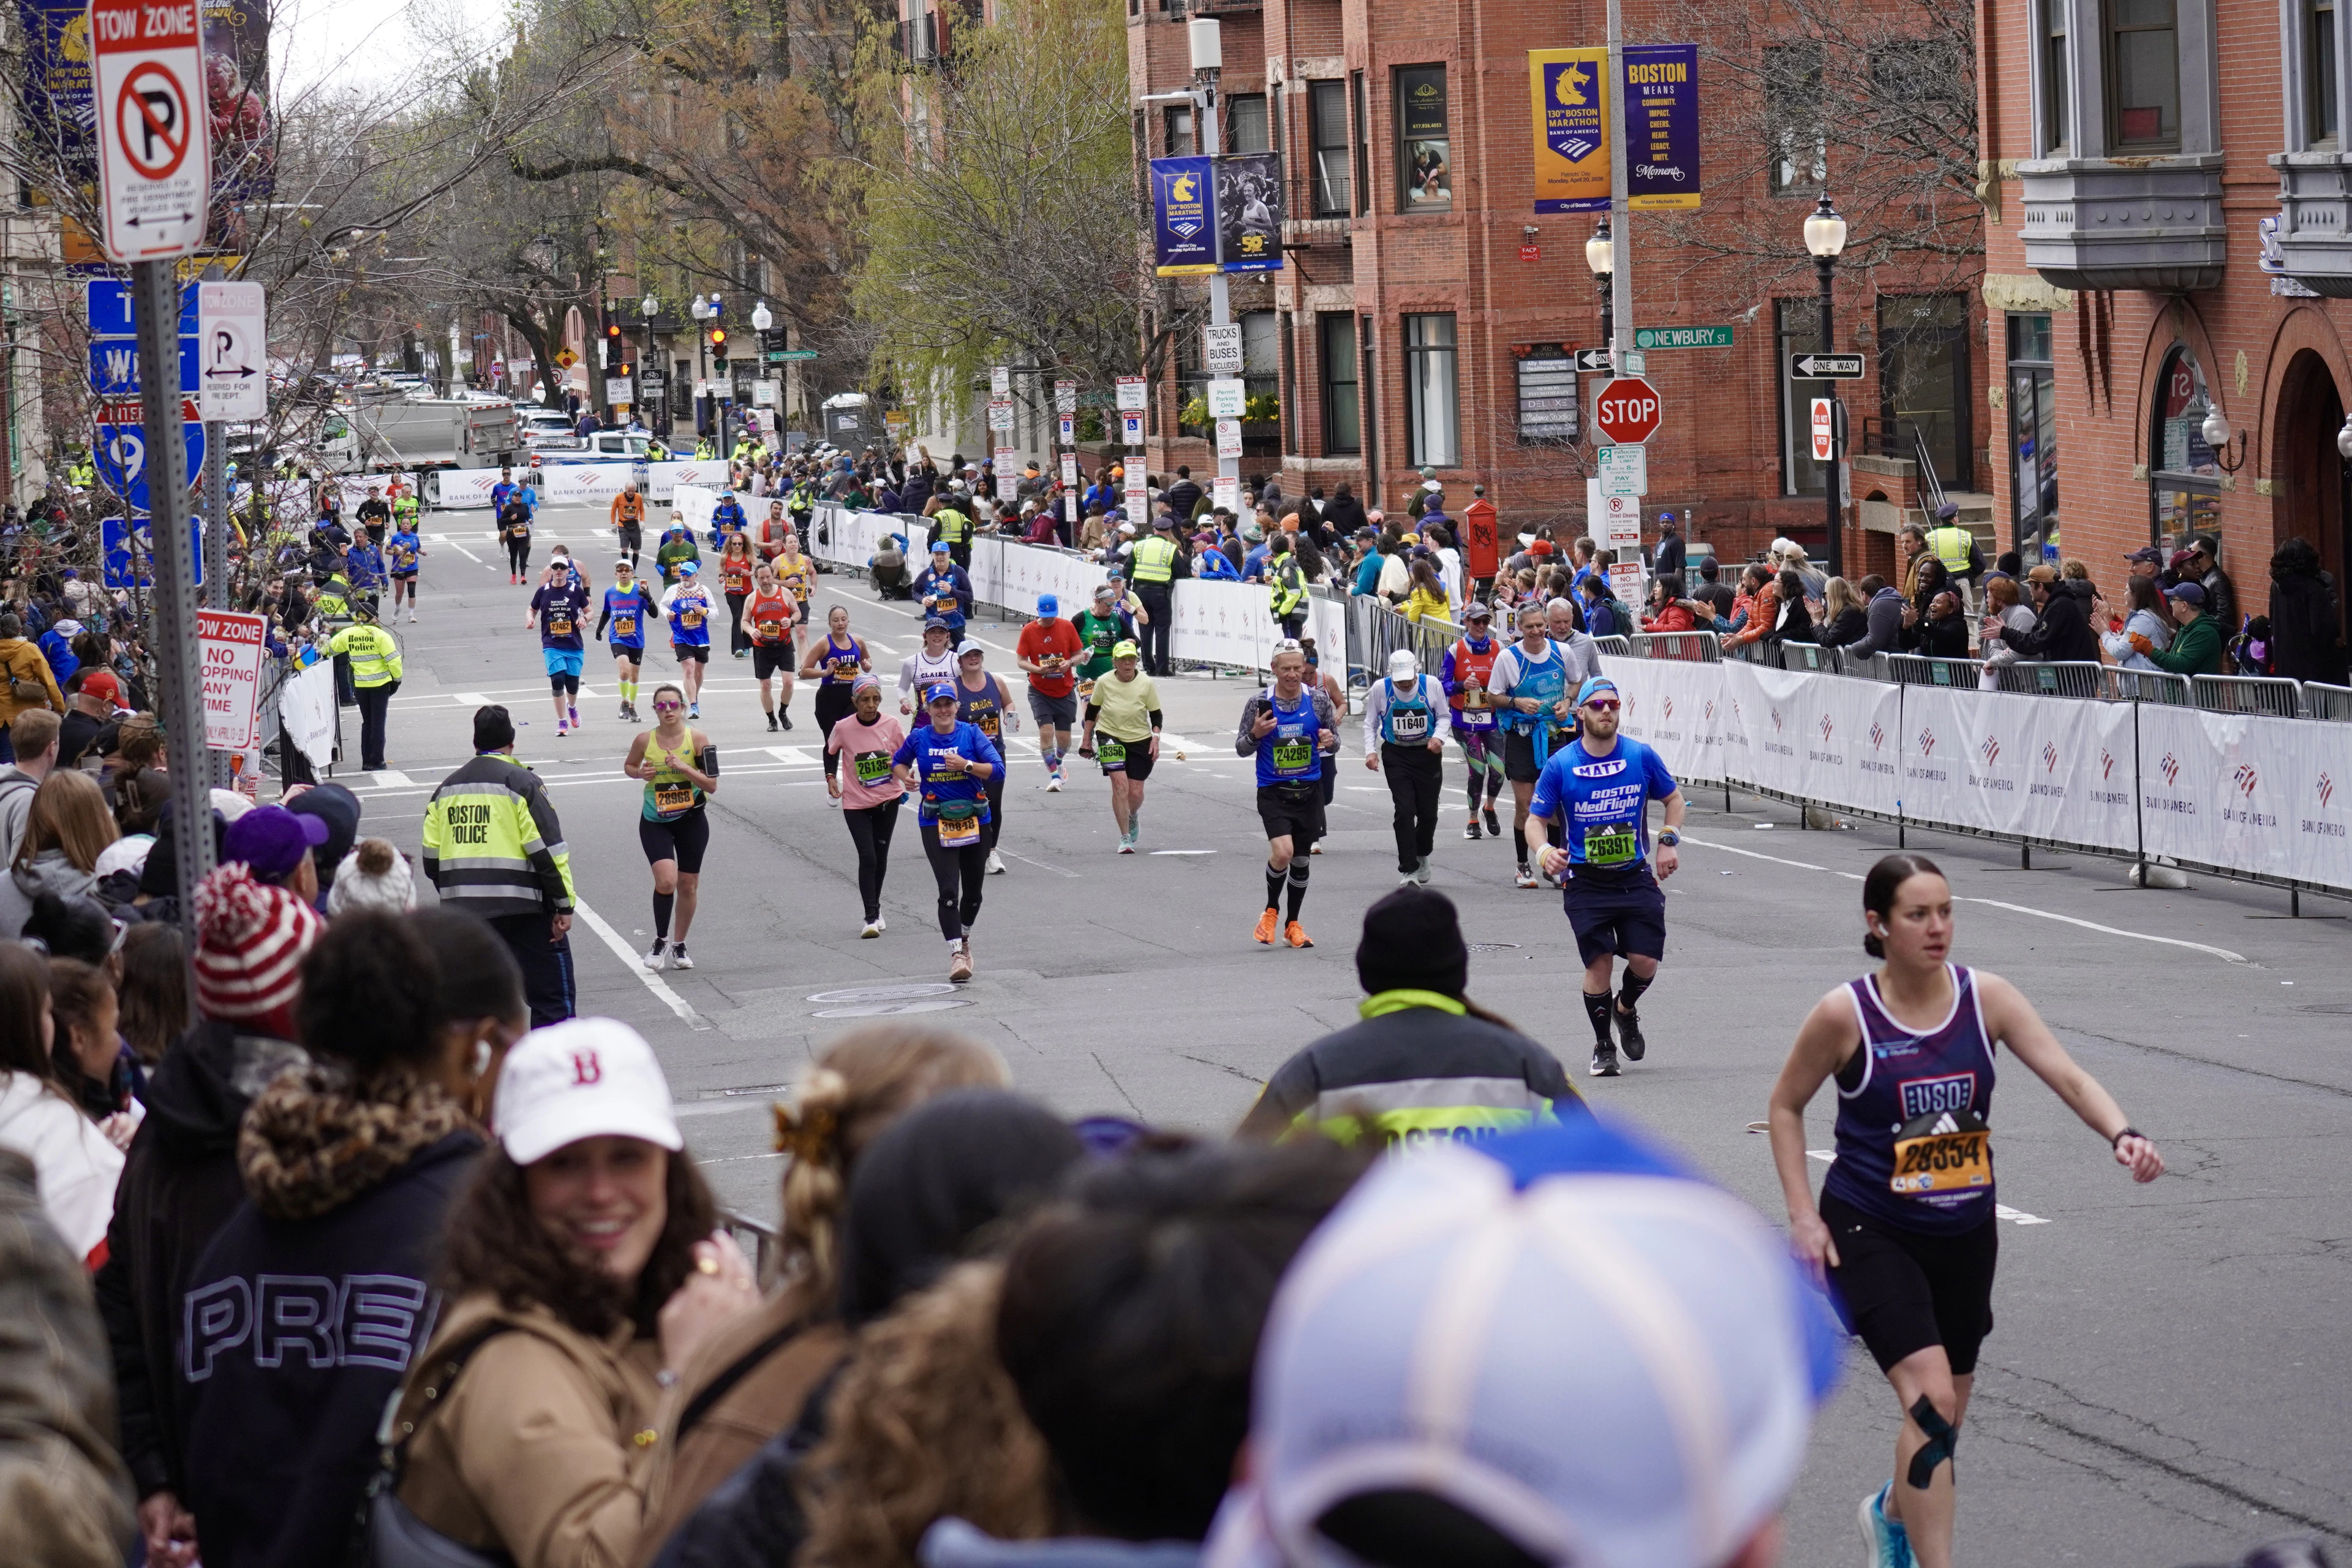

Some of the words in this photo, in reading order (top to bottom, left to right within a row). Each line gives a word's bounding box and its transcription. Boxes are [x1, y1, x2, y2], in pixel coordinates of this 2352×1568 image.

[96, 10, 137, 41] TOW
[145, 4, 195, 35] ZONE
[1629, 63, 1686, 83] BOSTON
[1643, 85, 1675, 95] MEANS
[1642, 98, 1676, 107] COMMUNITY.
[1566, 108, 1598, 117] BOSTON
[1549, 118, 1599, 127] MARATHON
[1636, 164, 1685, 181] Moments
[222, 295, 256, 307] ZONE
[1207, 328, 1237, 339] TRUCKS
[1655, 329, 1714, 345] NEWBURY
[1717, 334, 1726, 343] ST
[1210, 348, 1238, 359] BUSES
[1210, 361, 1240, 370] EXCLUDED
[1814, 362, 1831, 371] ONE
[1838, 362, 1856, 371] WAY
[1601, 398, 1656, 424] STOP
[1601, 450, 1611, 459] 2
[771, 603, 783, 611] CITY
[938, 599, 955, 608] 27201
[222, 622, 261, 641] ZONE
[552, 622, 570, 631] 27482
[616, 622, 634, 630] 31217
[349, 643, 375, 652] Police
[206, 647, 235, 665] NO
[202, 665, 254, 682] OPPING
[203, 682, 232, 696] ANY
[1396, 717, 1425, 730] 11640
[1471, 712, 1483, 722] Jo
[929, 747, 959, 756] STACEY
[1277, 746, 1309, 762] 24295
[858, 760, 888, 775] 26135
[1579, 761, 1621, 776] MATT
[1591, 783, 1642, 799] BOSTON
[1990, 778, 2014, 791] AMERICA
[658, 791, 690, 806] 28968
[1574, 794, 1640, 813] MedFlight
[447, 805, 490, 825] BOSTON
[941, 819, 975, 832] 30848
[2323, 823, 2345, 837] AMERICA
[452, 825, 488, 845] POLICE
[1589, 836, 1630, 857] 26391
[1915, 1081, 1961, 1114] USO
[1901, 1136, 1981, 1174] 28354
